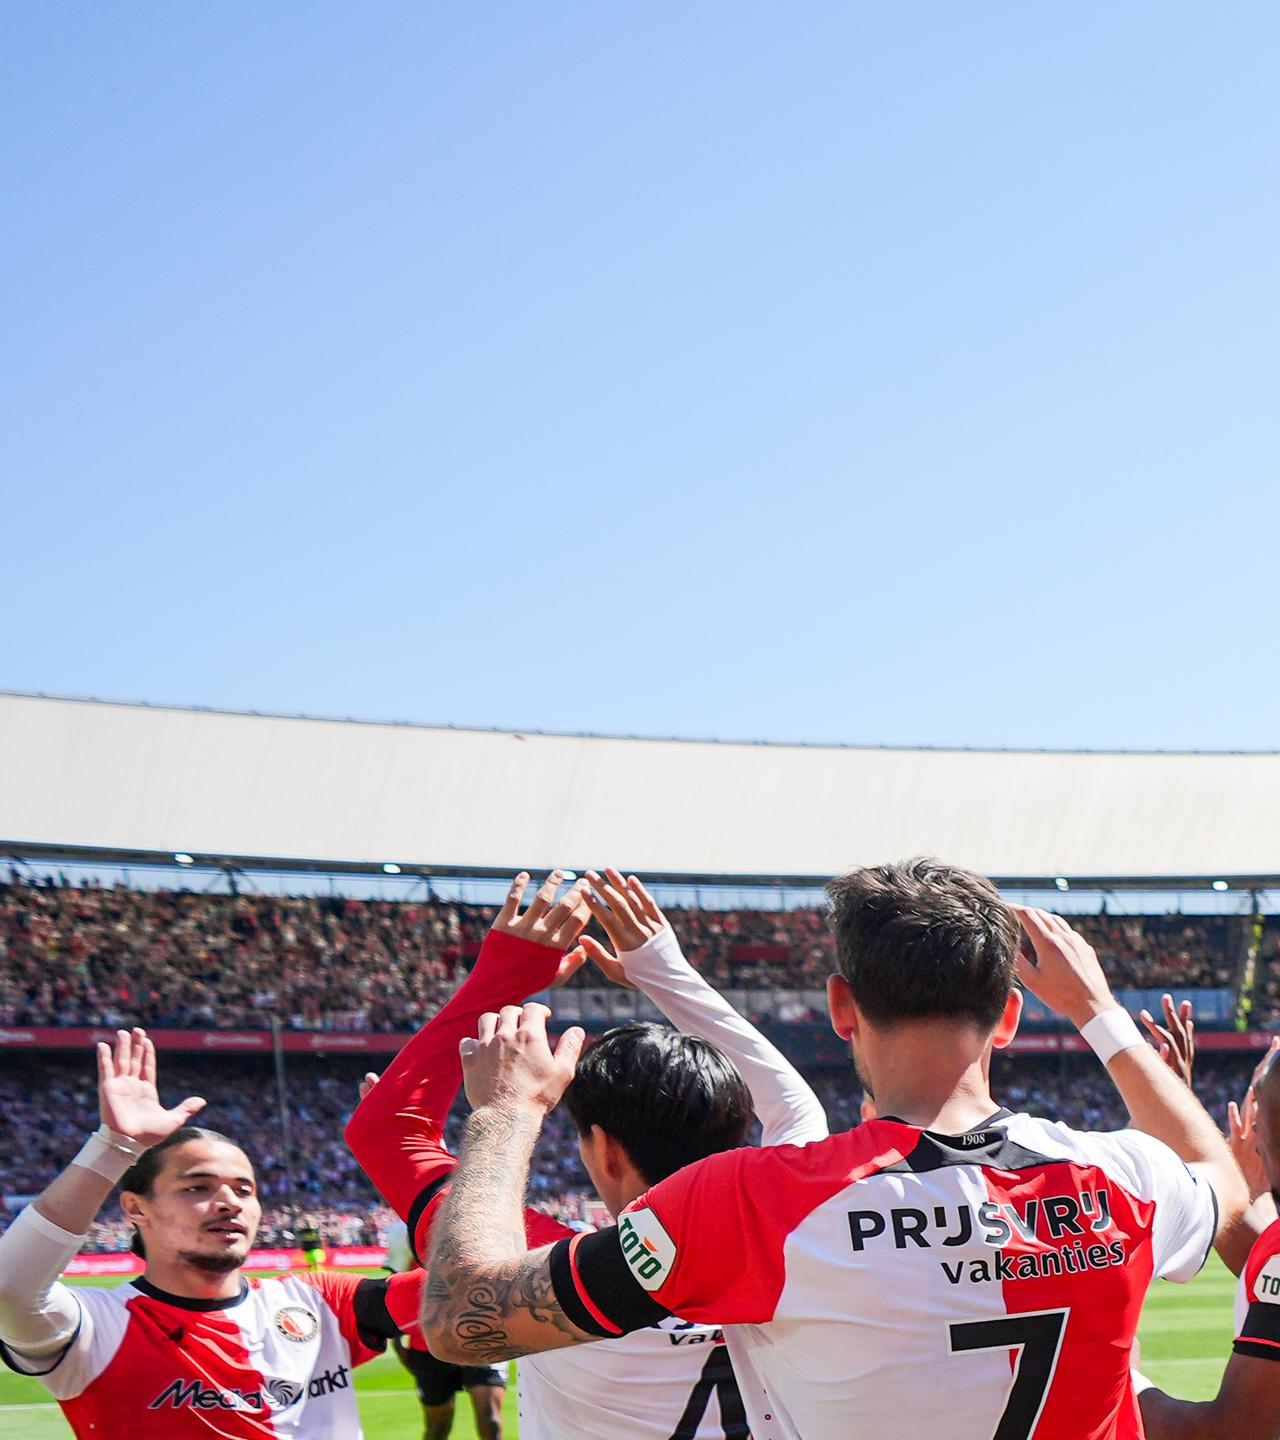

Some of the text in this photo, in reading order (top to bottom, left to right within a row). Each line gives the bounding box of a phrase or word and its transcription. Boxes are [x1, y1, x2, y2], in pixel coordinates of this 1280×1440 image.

[961, 1132, 986, 1146] 1908
[847, 1189, 1112, 1252] PRIJSVRIJ
[618, 1217, 663, 1280] TOTO
[940, 1239, 1125, 1285] vakanties
